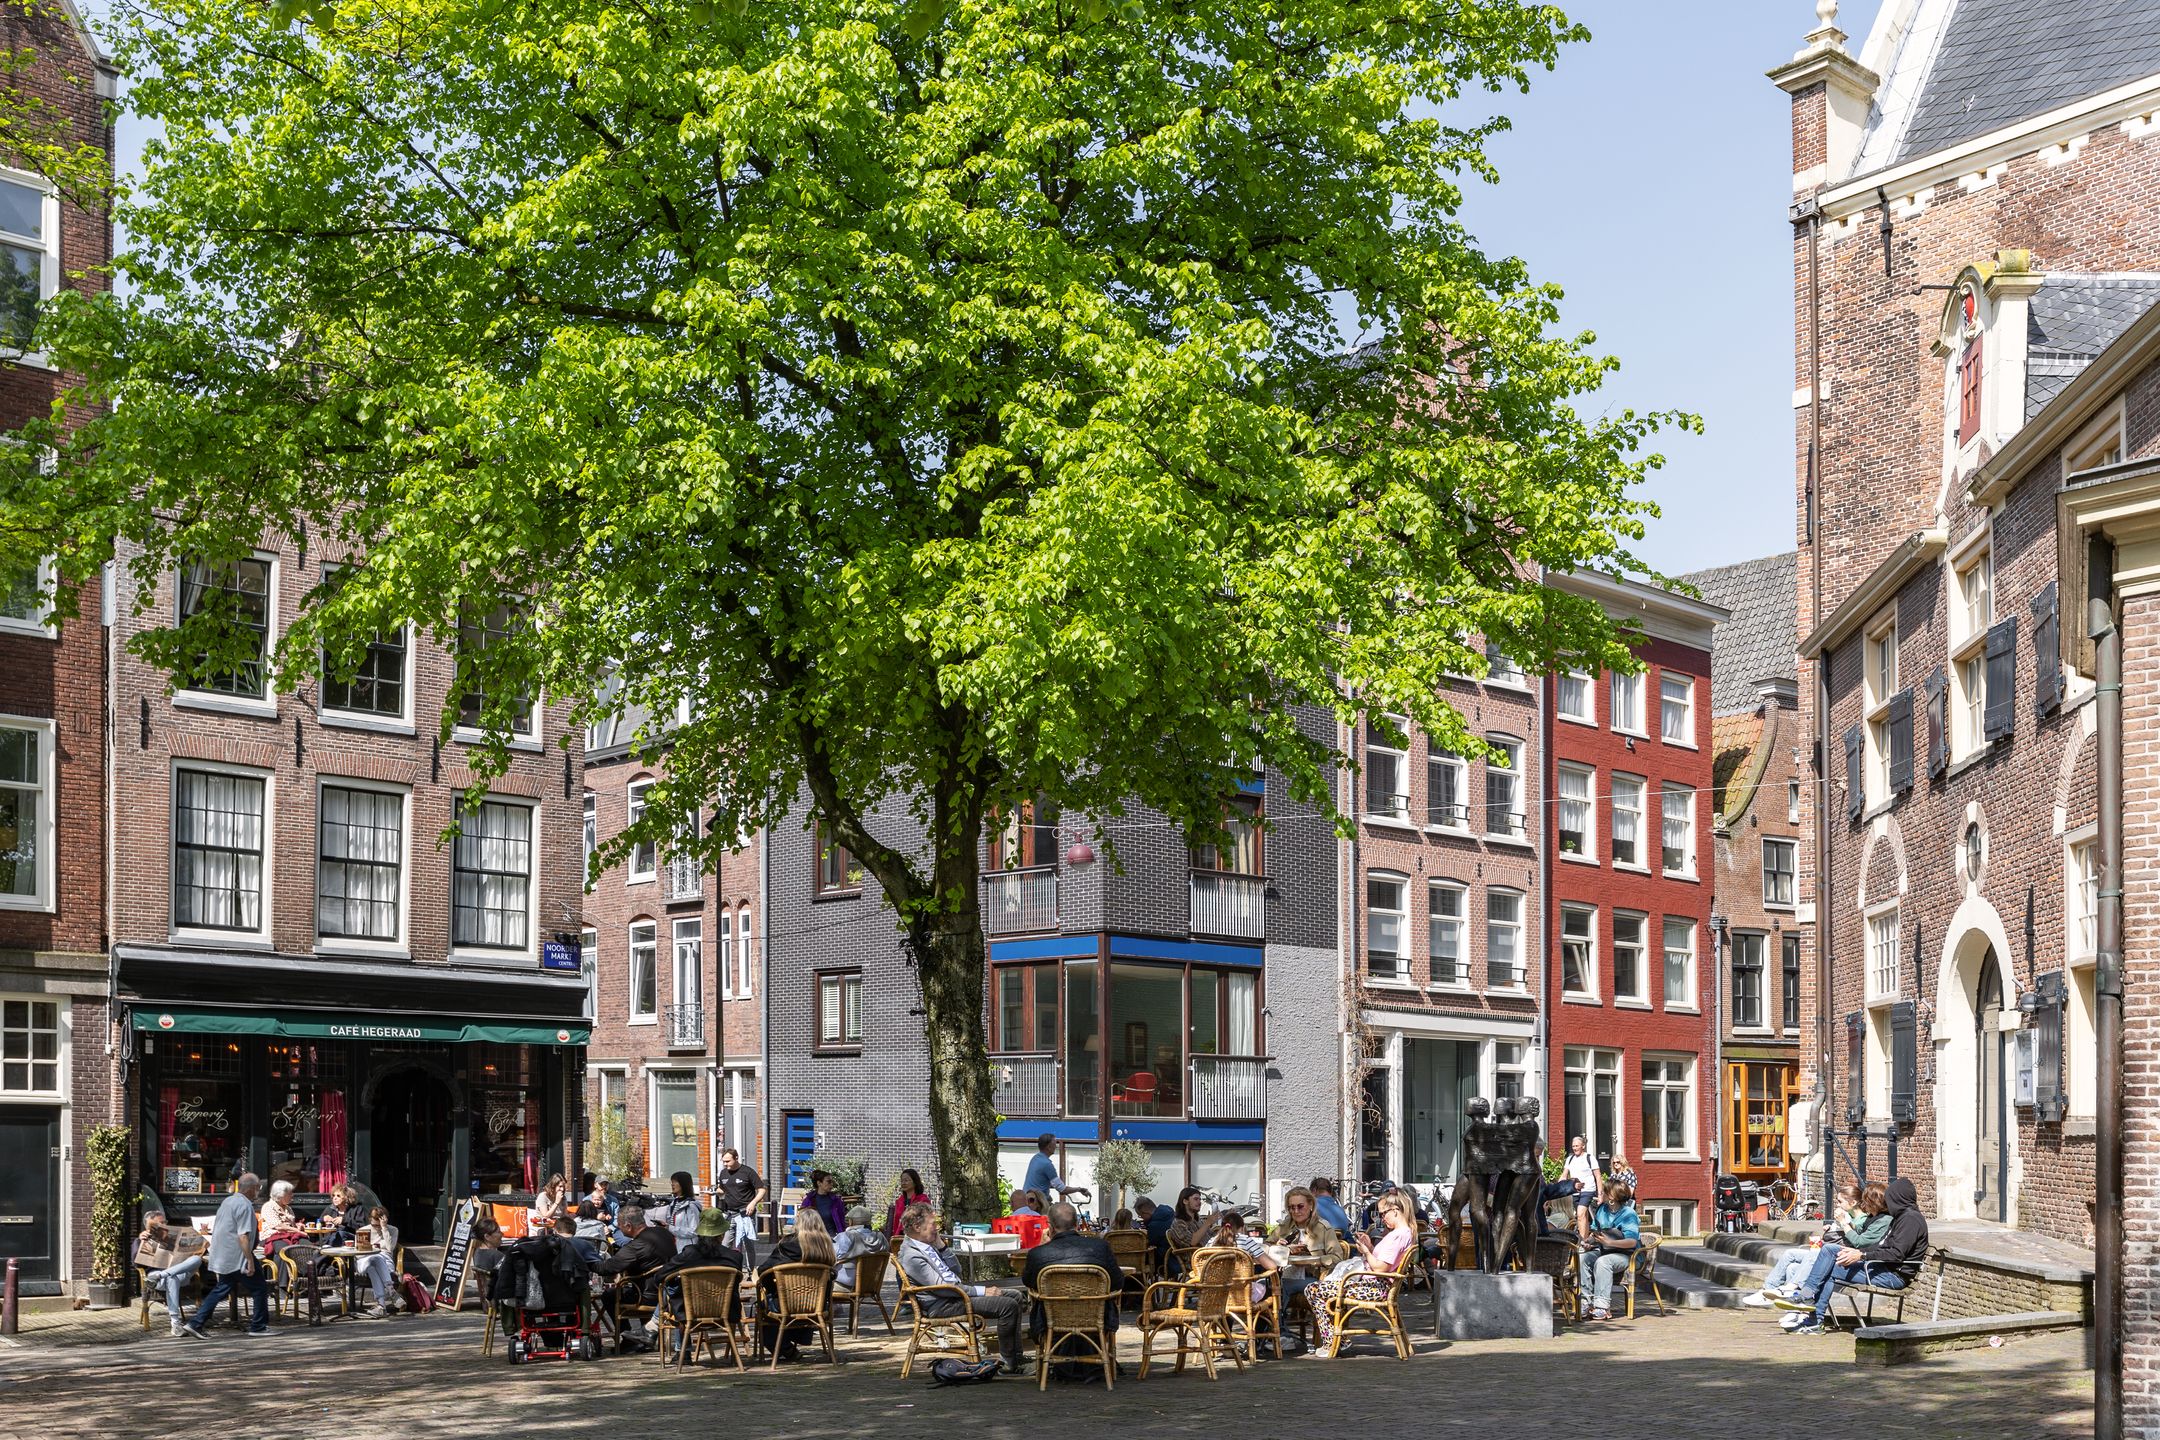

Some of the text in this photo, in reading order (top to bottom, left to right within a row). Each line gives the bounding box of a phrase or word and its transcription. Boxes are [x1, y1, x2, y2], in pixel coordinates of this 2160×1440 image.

[546, 944, 578, 953] NOORDER
[551, 952, 573, 961] MARKT
[330, 1024, 421, 1038] CAFÉ HEGERAAD
[489, 1107, 522, 1133] Caf
